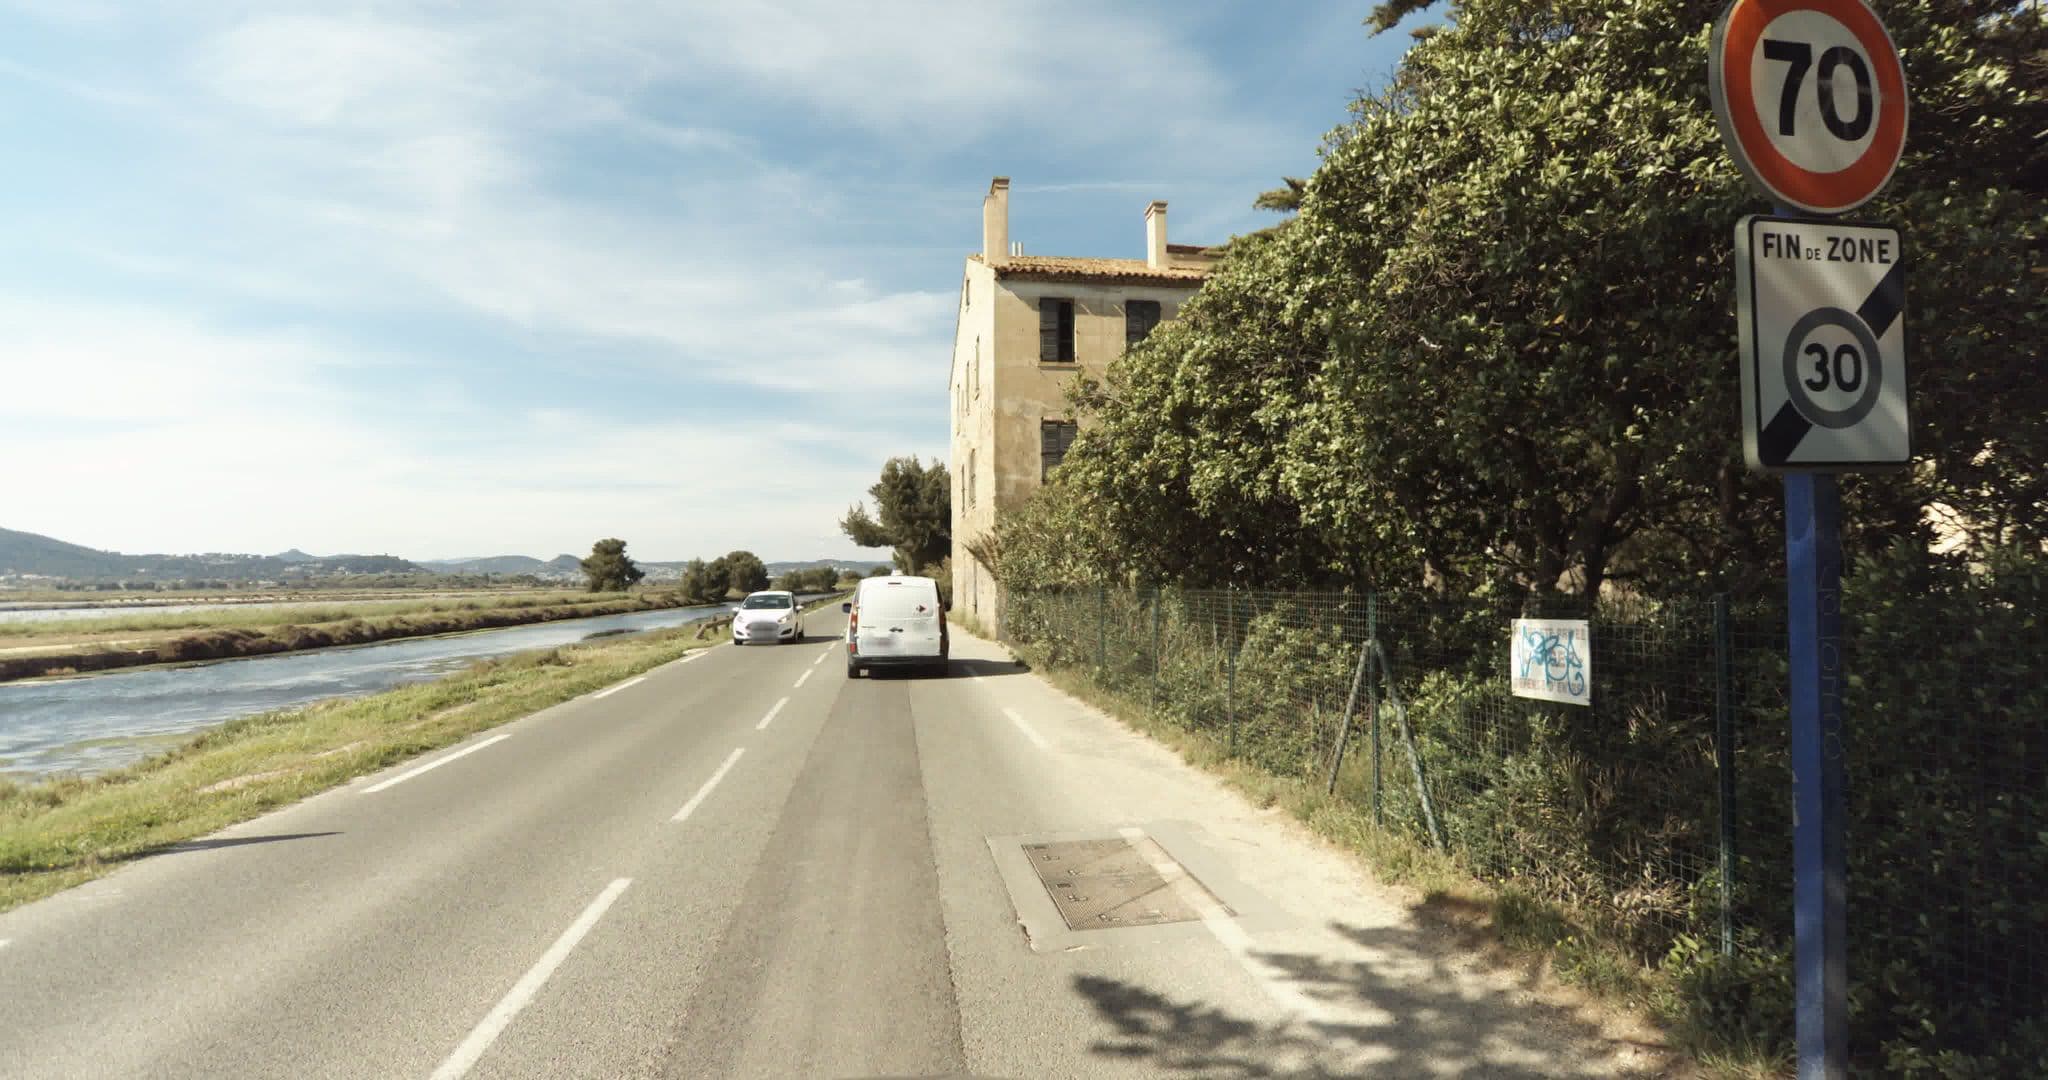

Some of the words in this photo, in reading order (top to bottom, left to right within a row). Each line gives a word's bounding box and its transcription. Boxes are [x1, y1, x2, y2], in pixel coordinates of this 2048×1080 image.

[1763, 39, 1873, 141] 70
[1763, 233, 1800, 259] FIN
[1806, 248, 1821, 260] DE
[1826, 237, 1891, 264] ZONE
[1804, 343, 1862, 392] 30
